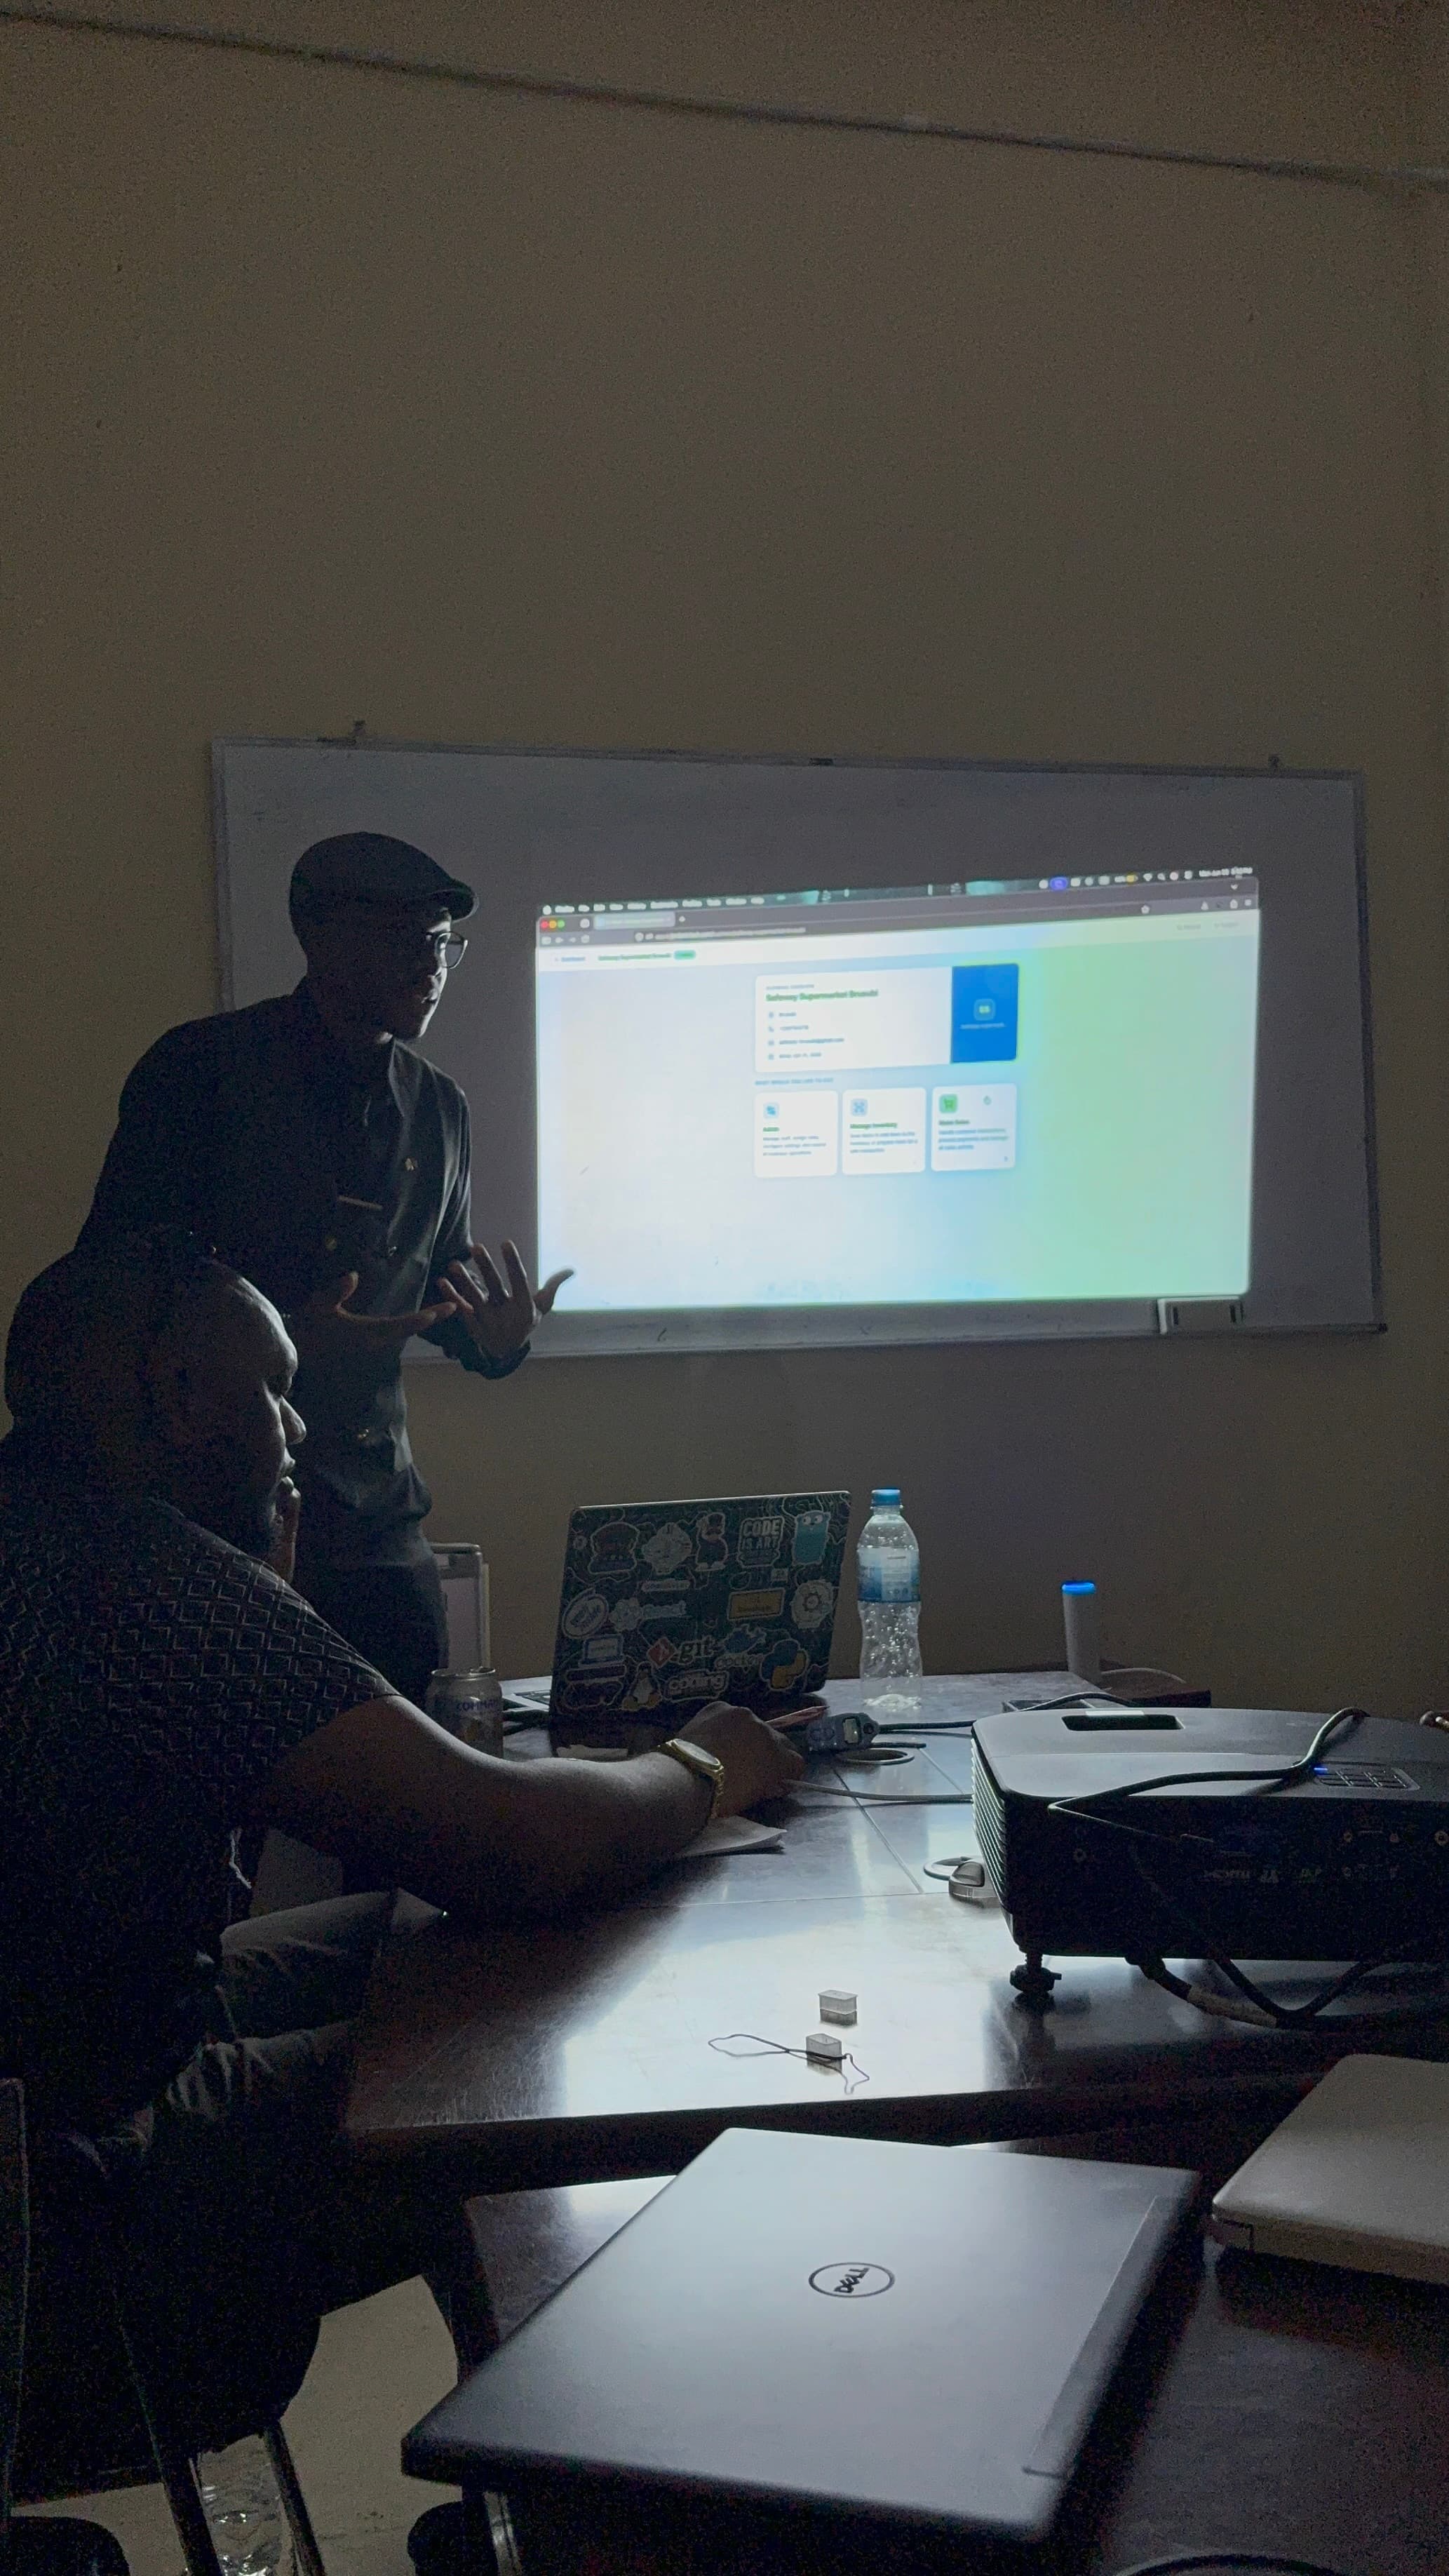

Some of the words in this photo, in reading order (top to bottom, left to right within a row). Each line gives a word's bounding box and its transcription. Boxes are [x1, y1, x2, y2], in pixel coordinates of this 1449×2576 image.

[743, 1520, 779, 1536] CODE
[742, 1538, 753, 1549] IS
[756, 1536, 779, 1549] ART
[681, 1638, 714, 1663] git
[835, 2267, 869, 2293] DELL
